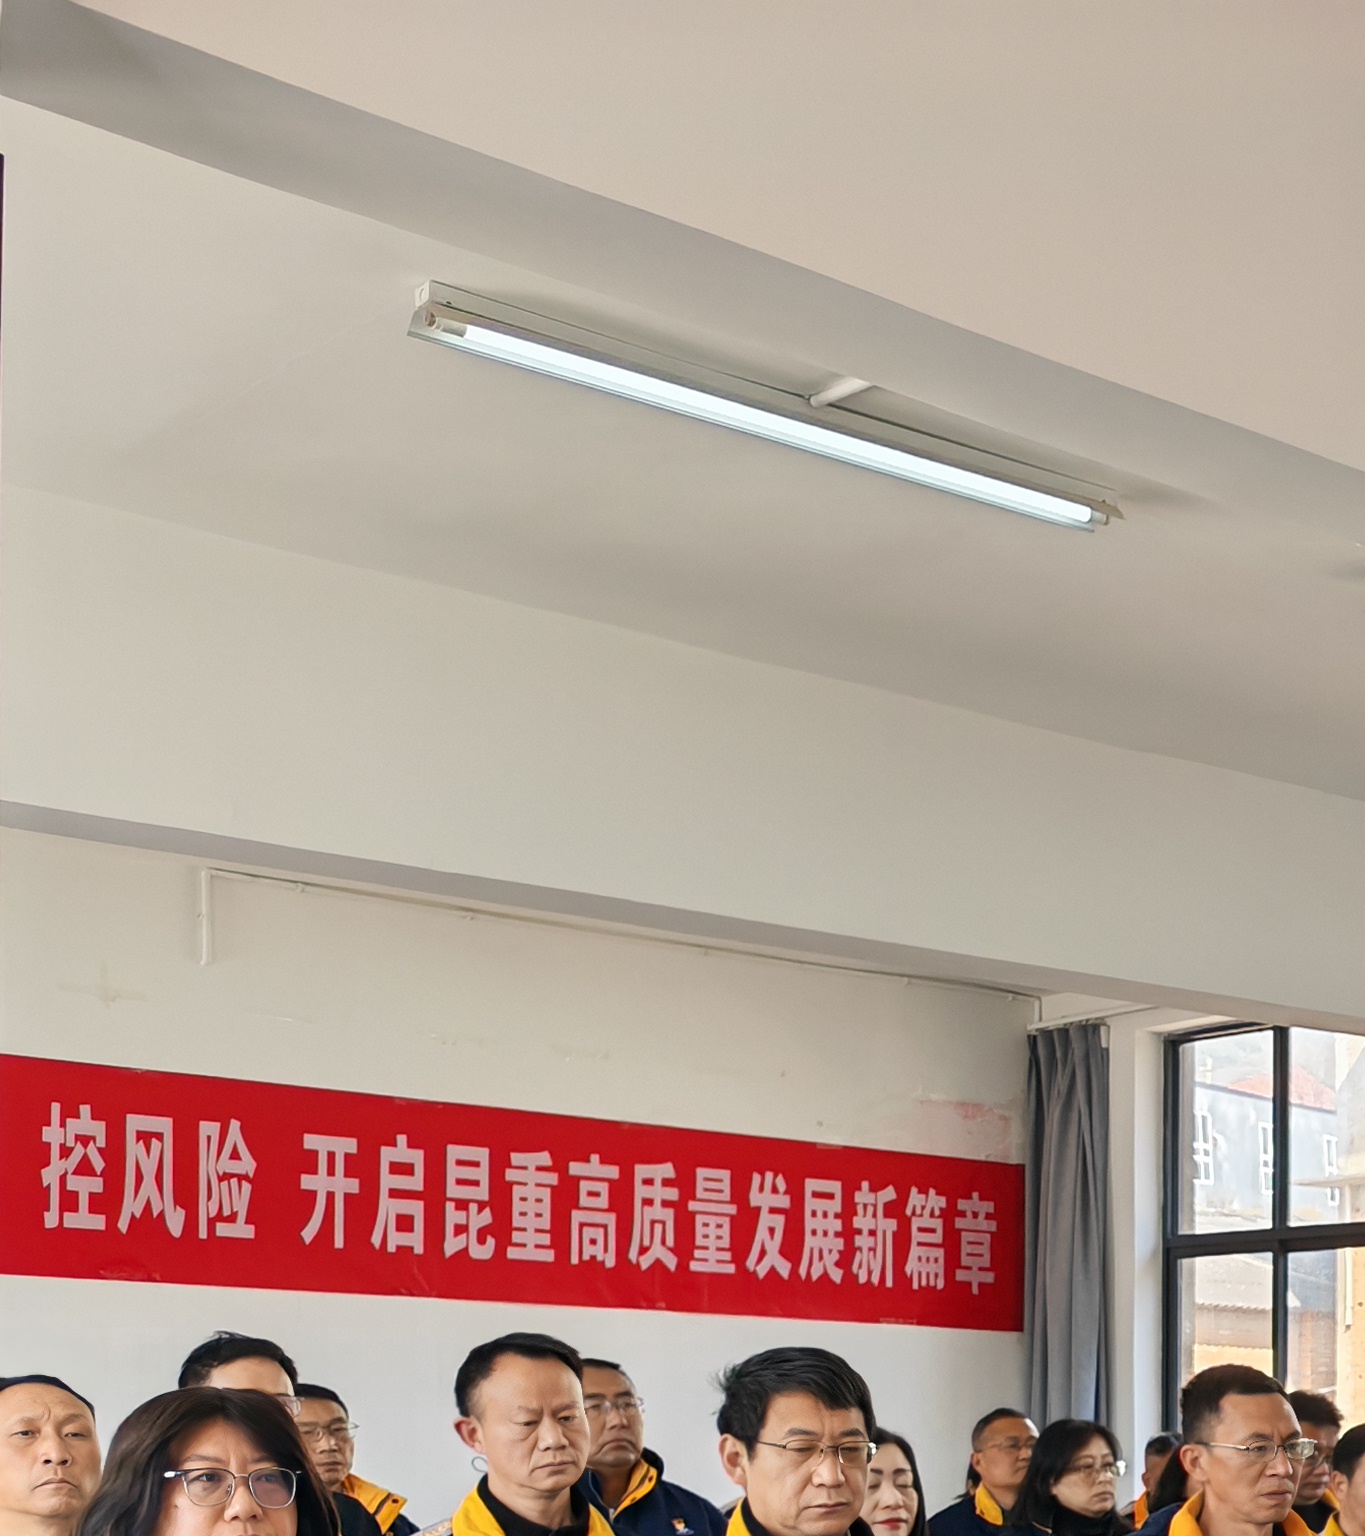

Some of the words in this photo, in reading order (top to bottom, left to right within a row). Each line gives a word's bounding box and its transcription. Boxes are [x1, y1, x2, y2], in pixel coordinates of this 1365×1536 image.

[41, 1100, 258, 1240] 控风险
[299, 1131, 999, 1296] 开启昆重高质量发展新篇章
